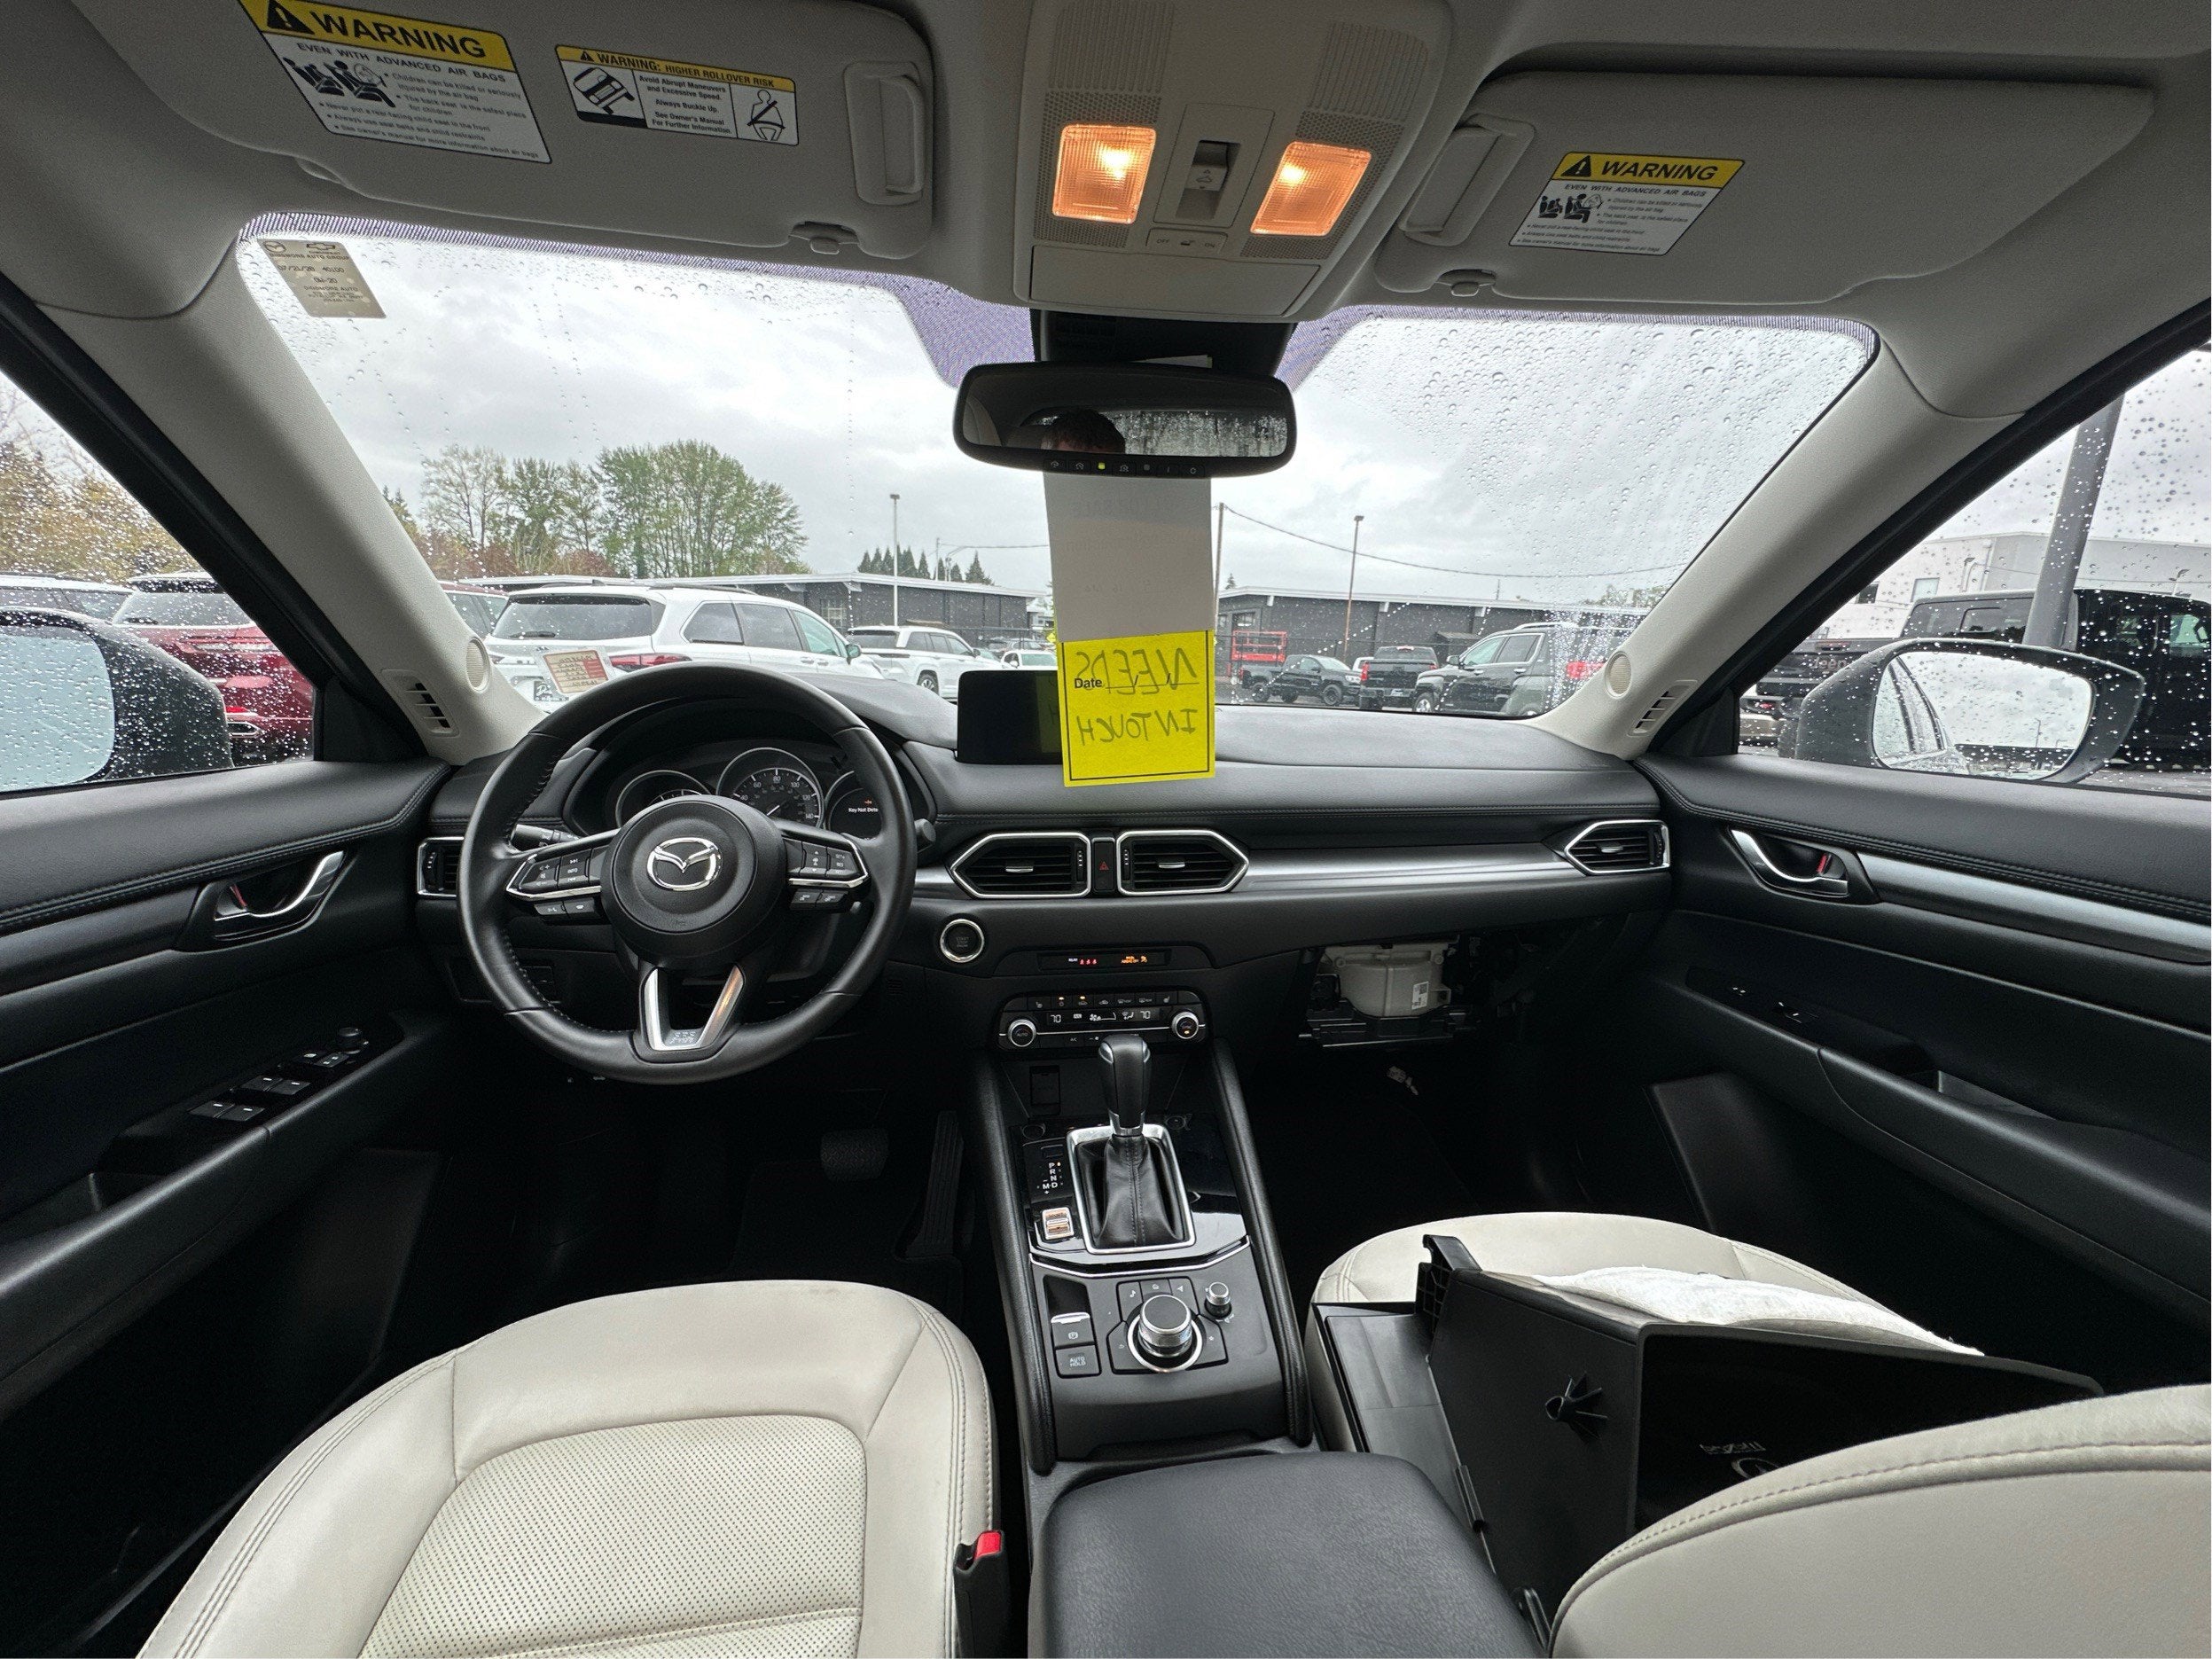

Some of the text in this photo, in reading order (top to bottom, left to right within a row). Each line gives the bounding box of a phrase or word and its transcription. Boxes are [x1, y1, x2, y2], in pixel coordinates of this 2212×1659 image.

[309, 10, 486, 59] WARNING
[296, 43, 505, 82] EVEN WITH ADVANCED AIR BAGS
[597, 52, 775, 88] WARNING: HIGHER ROLLOVER RISK
[639, 75, 660, 84] Avoid
[661, 78, 685, 89] Abrupt
[661, 86, 696, 97] Excessive
[655, 98, 680, 109] Always
[683, 102, 707, 112] Buckle
[1601, 160, 1718, 181] WARNING
[1614, 184, 1661, 195] ADVANCED
[1074, 677, 1103, 690] Date
[1051, 1014, 1061, 1023] 70
[1140, 1011, 1151, 1020] 70
